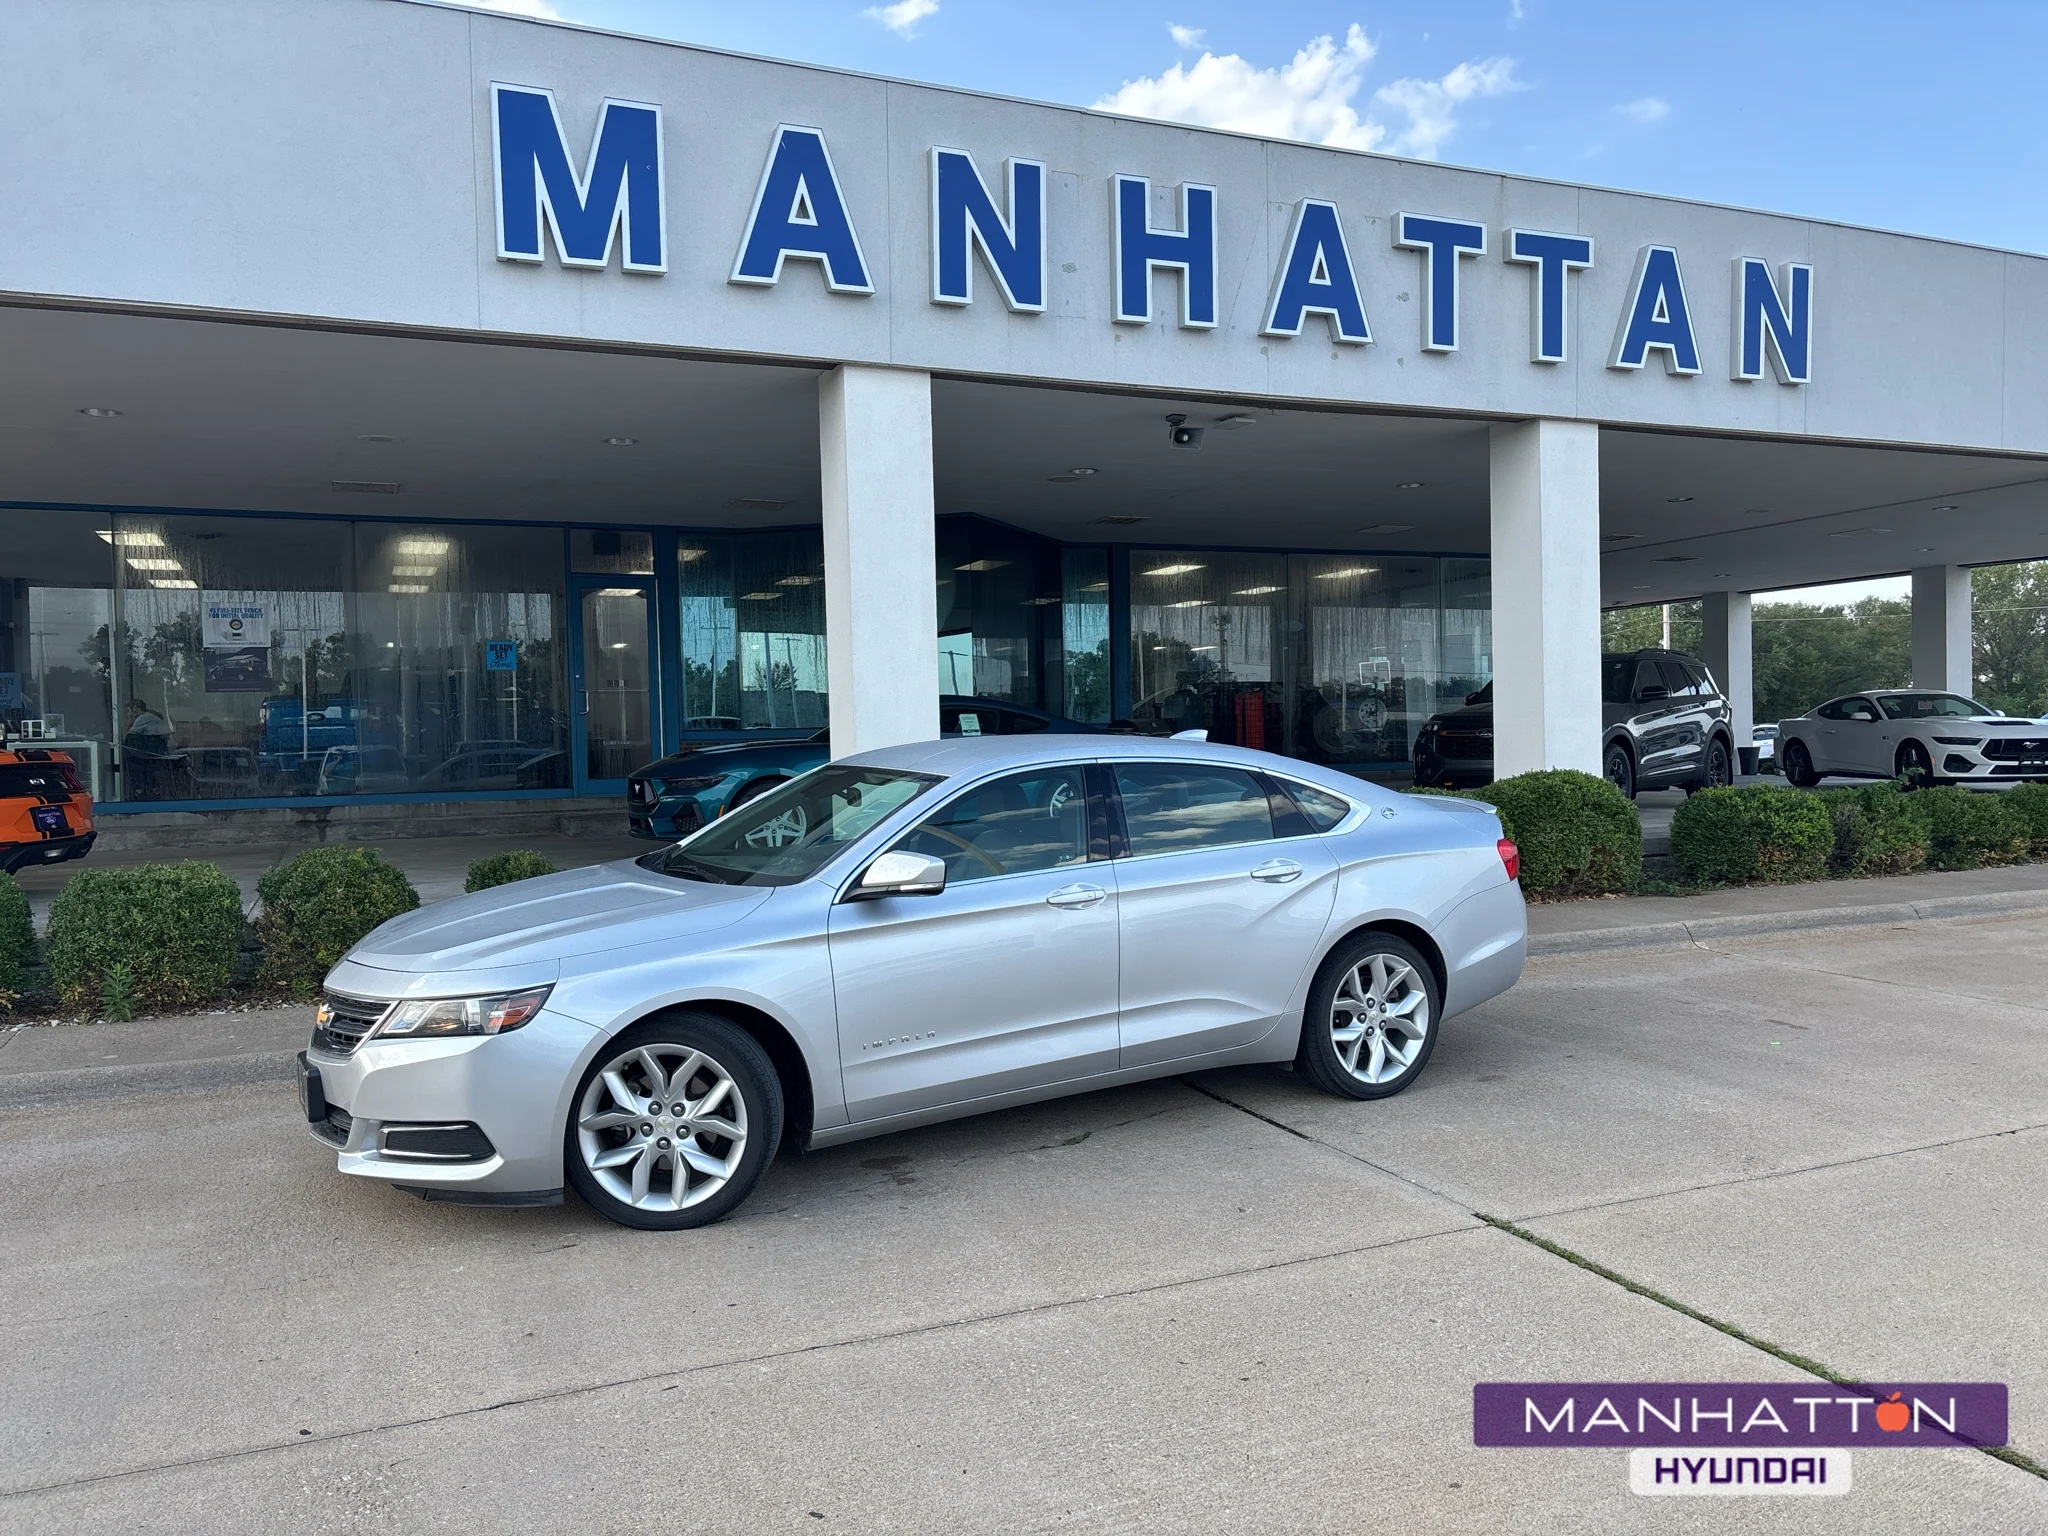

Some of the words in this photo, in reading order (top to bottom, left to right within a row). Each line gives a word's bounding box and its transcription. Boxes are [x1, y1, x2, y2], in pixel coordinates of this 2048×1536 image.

[491, 82, 1815, 385] MANHATTAN
[489, 643, 513, 652] READY
[495, 651, 508, 660] SET
[490, 659, 512, 668] Ford
[863, 1030, 936, 1050] IMPALA
